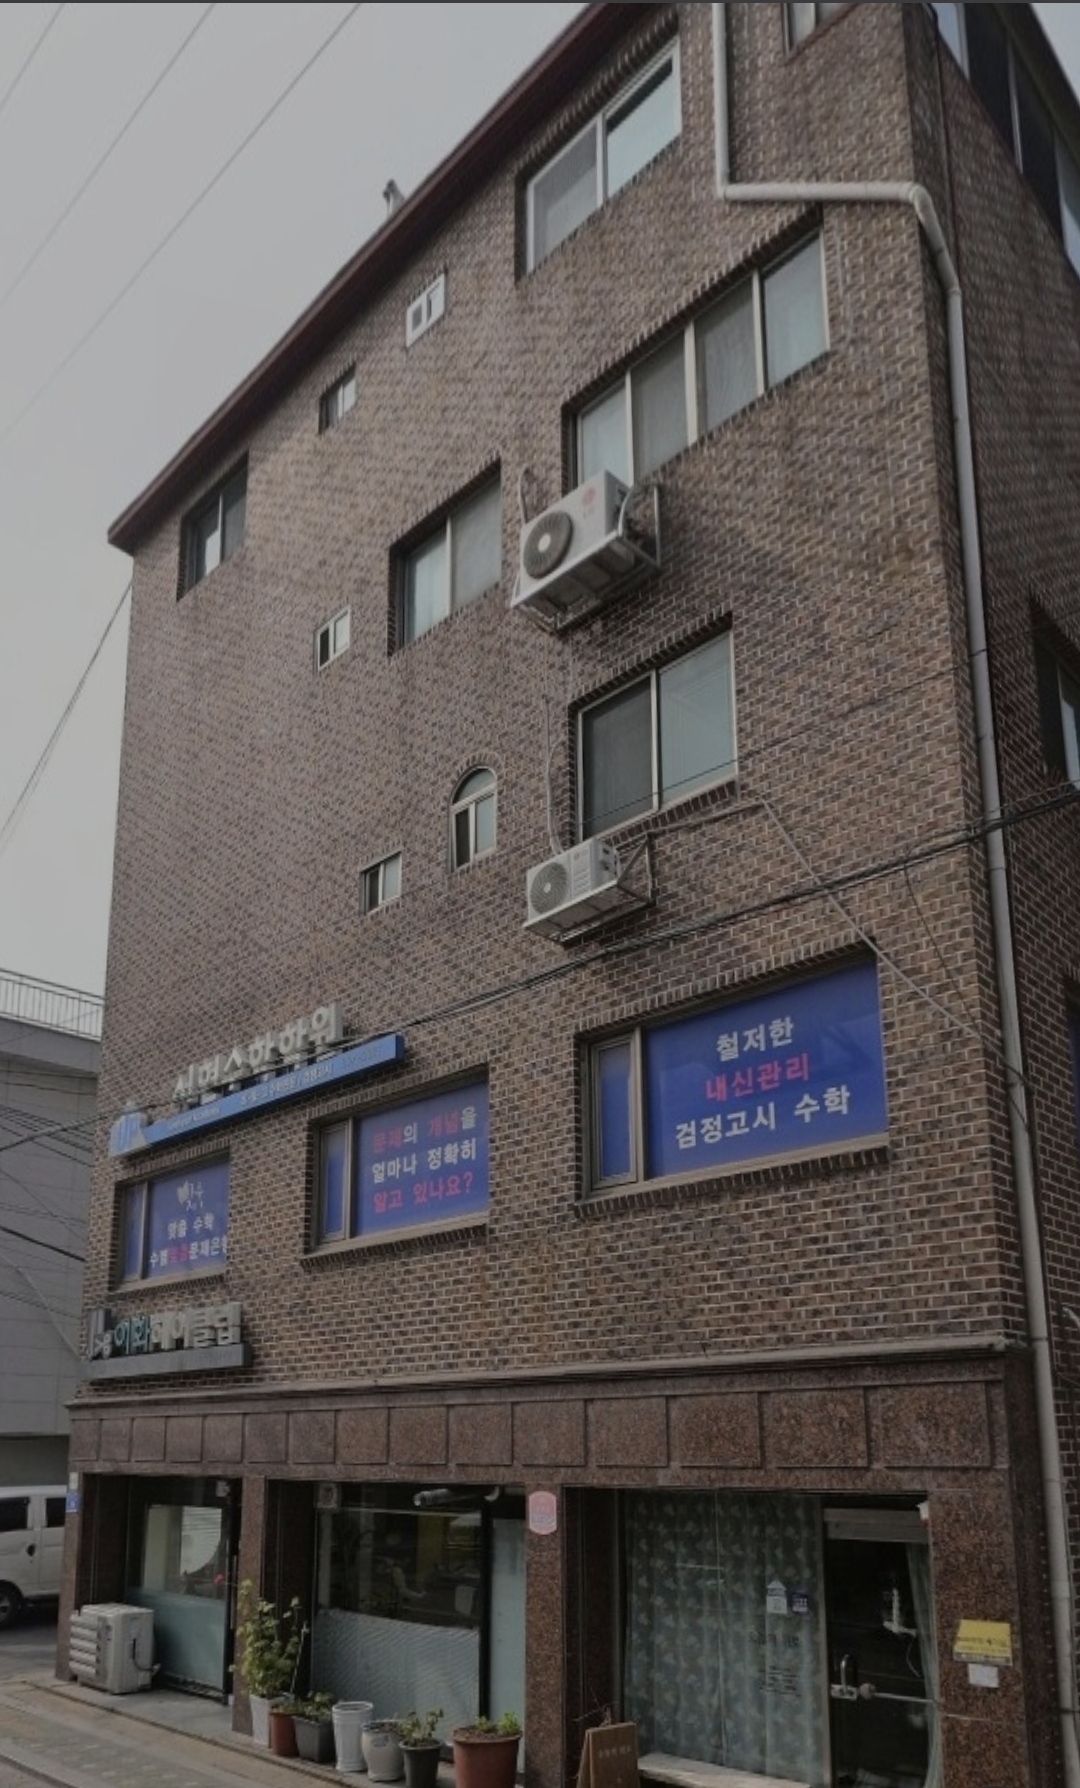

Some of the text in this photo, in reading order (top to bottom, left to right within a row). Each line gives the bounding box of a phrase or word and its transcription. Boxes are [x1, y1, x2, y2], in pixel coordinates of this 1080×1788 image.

[716, 1015, 795, 1061] 철저한
[705, 1053, 810, 1102] 내신관리
[429, 1105, 477, 1137] 개념을
[675, 1085, 852, 1150] 검정고시 수학
[371, 1138, 477, 1185] 얼마나 정확히
[373, 1171, 474, 1213] 알고 있나요?
